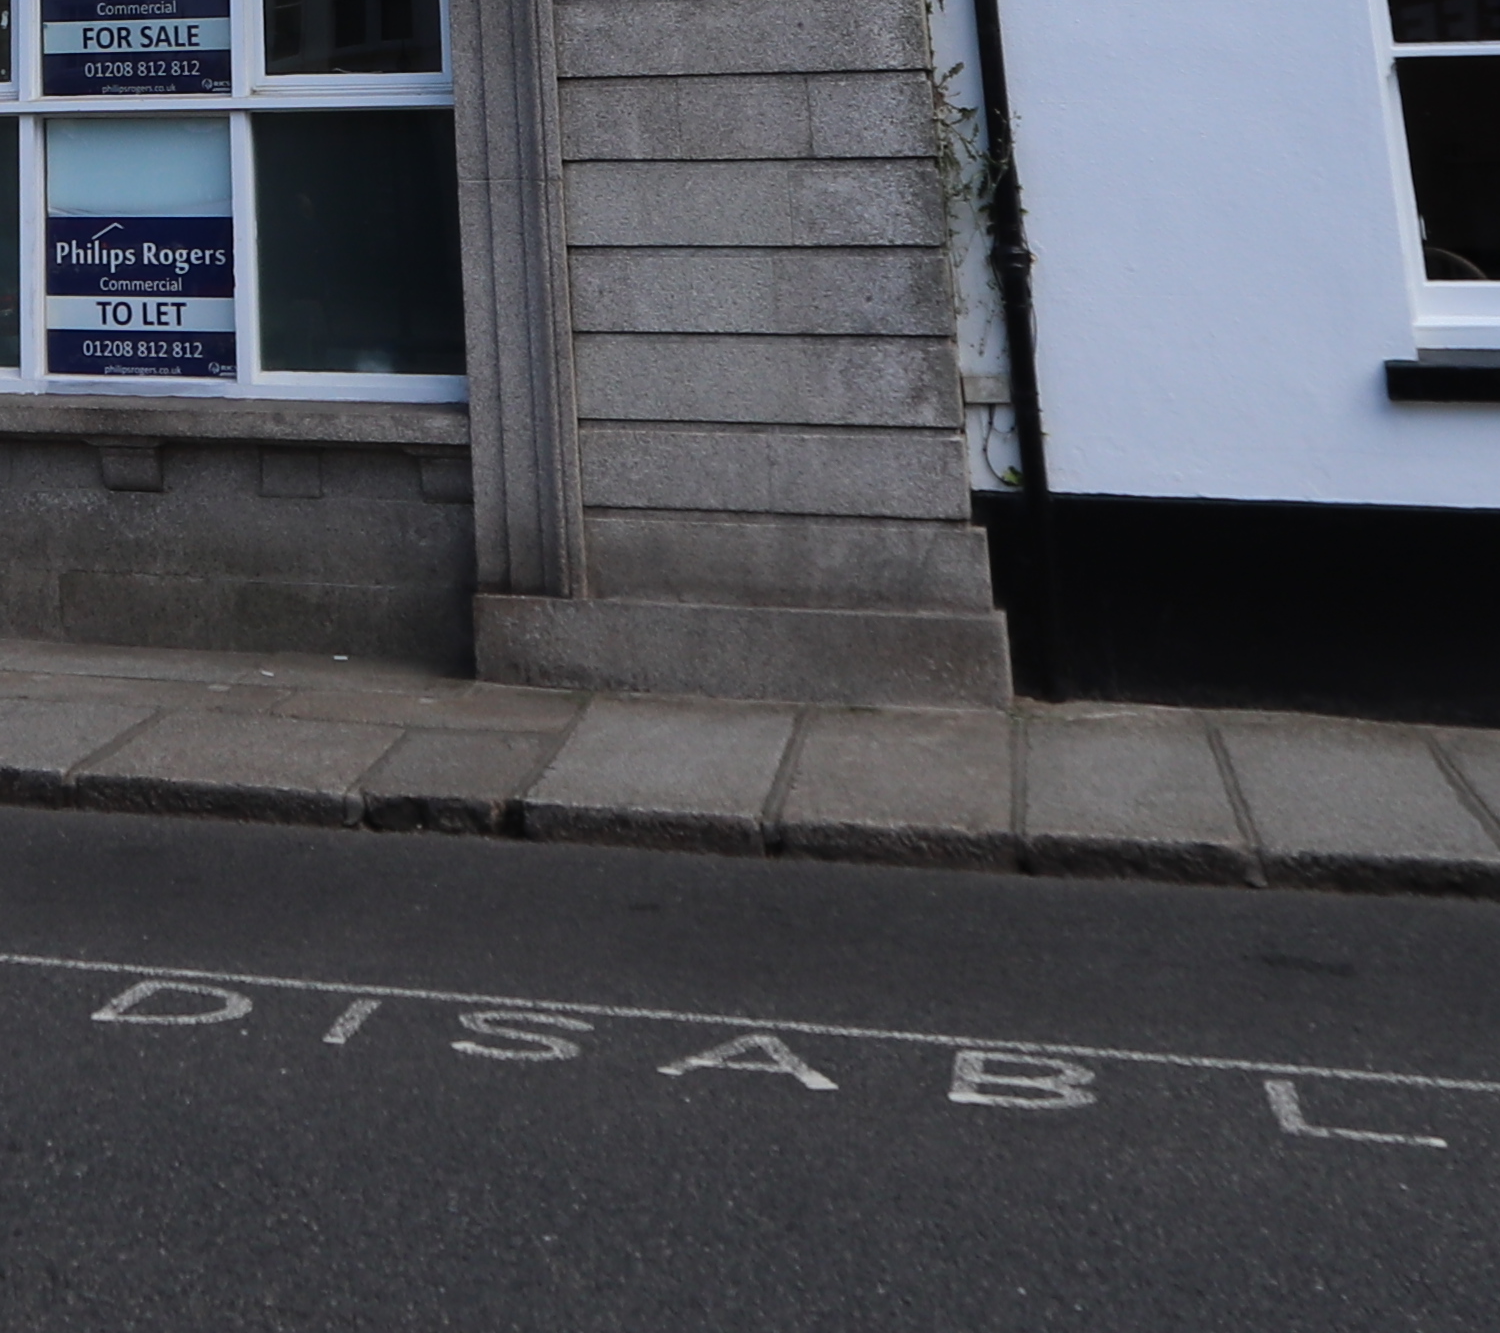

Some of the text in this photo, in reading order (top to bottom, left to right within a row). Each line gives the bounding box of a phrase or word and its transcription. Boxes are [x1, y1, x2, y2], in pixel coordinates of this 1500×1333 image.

[96, 0, 177, 16] Commercial
[82, 24, 201, 50] FOR SALE
[84, 60, 201, 78] 01208 812 812
[101, 83, 177, 95] philipsrogers.co.uk
[56, 239, 227, 275] Philips Rogers
[100, 276, 183, 292] Commercial
[96, 301, 188, 327] TO LET
[83, 340, 204, 359] 01208 812 812
[104, 365, 182, 376] philipsrogers.co.uk
